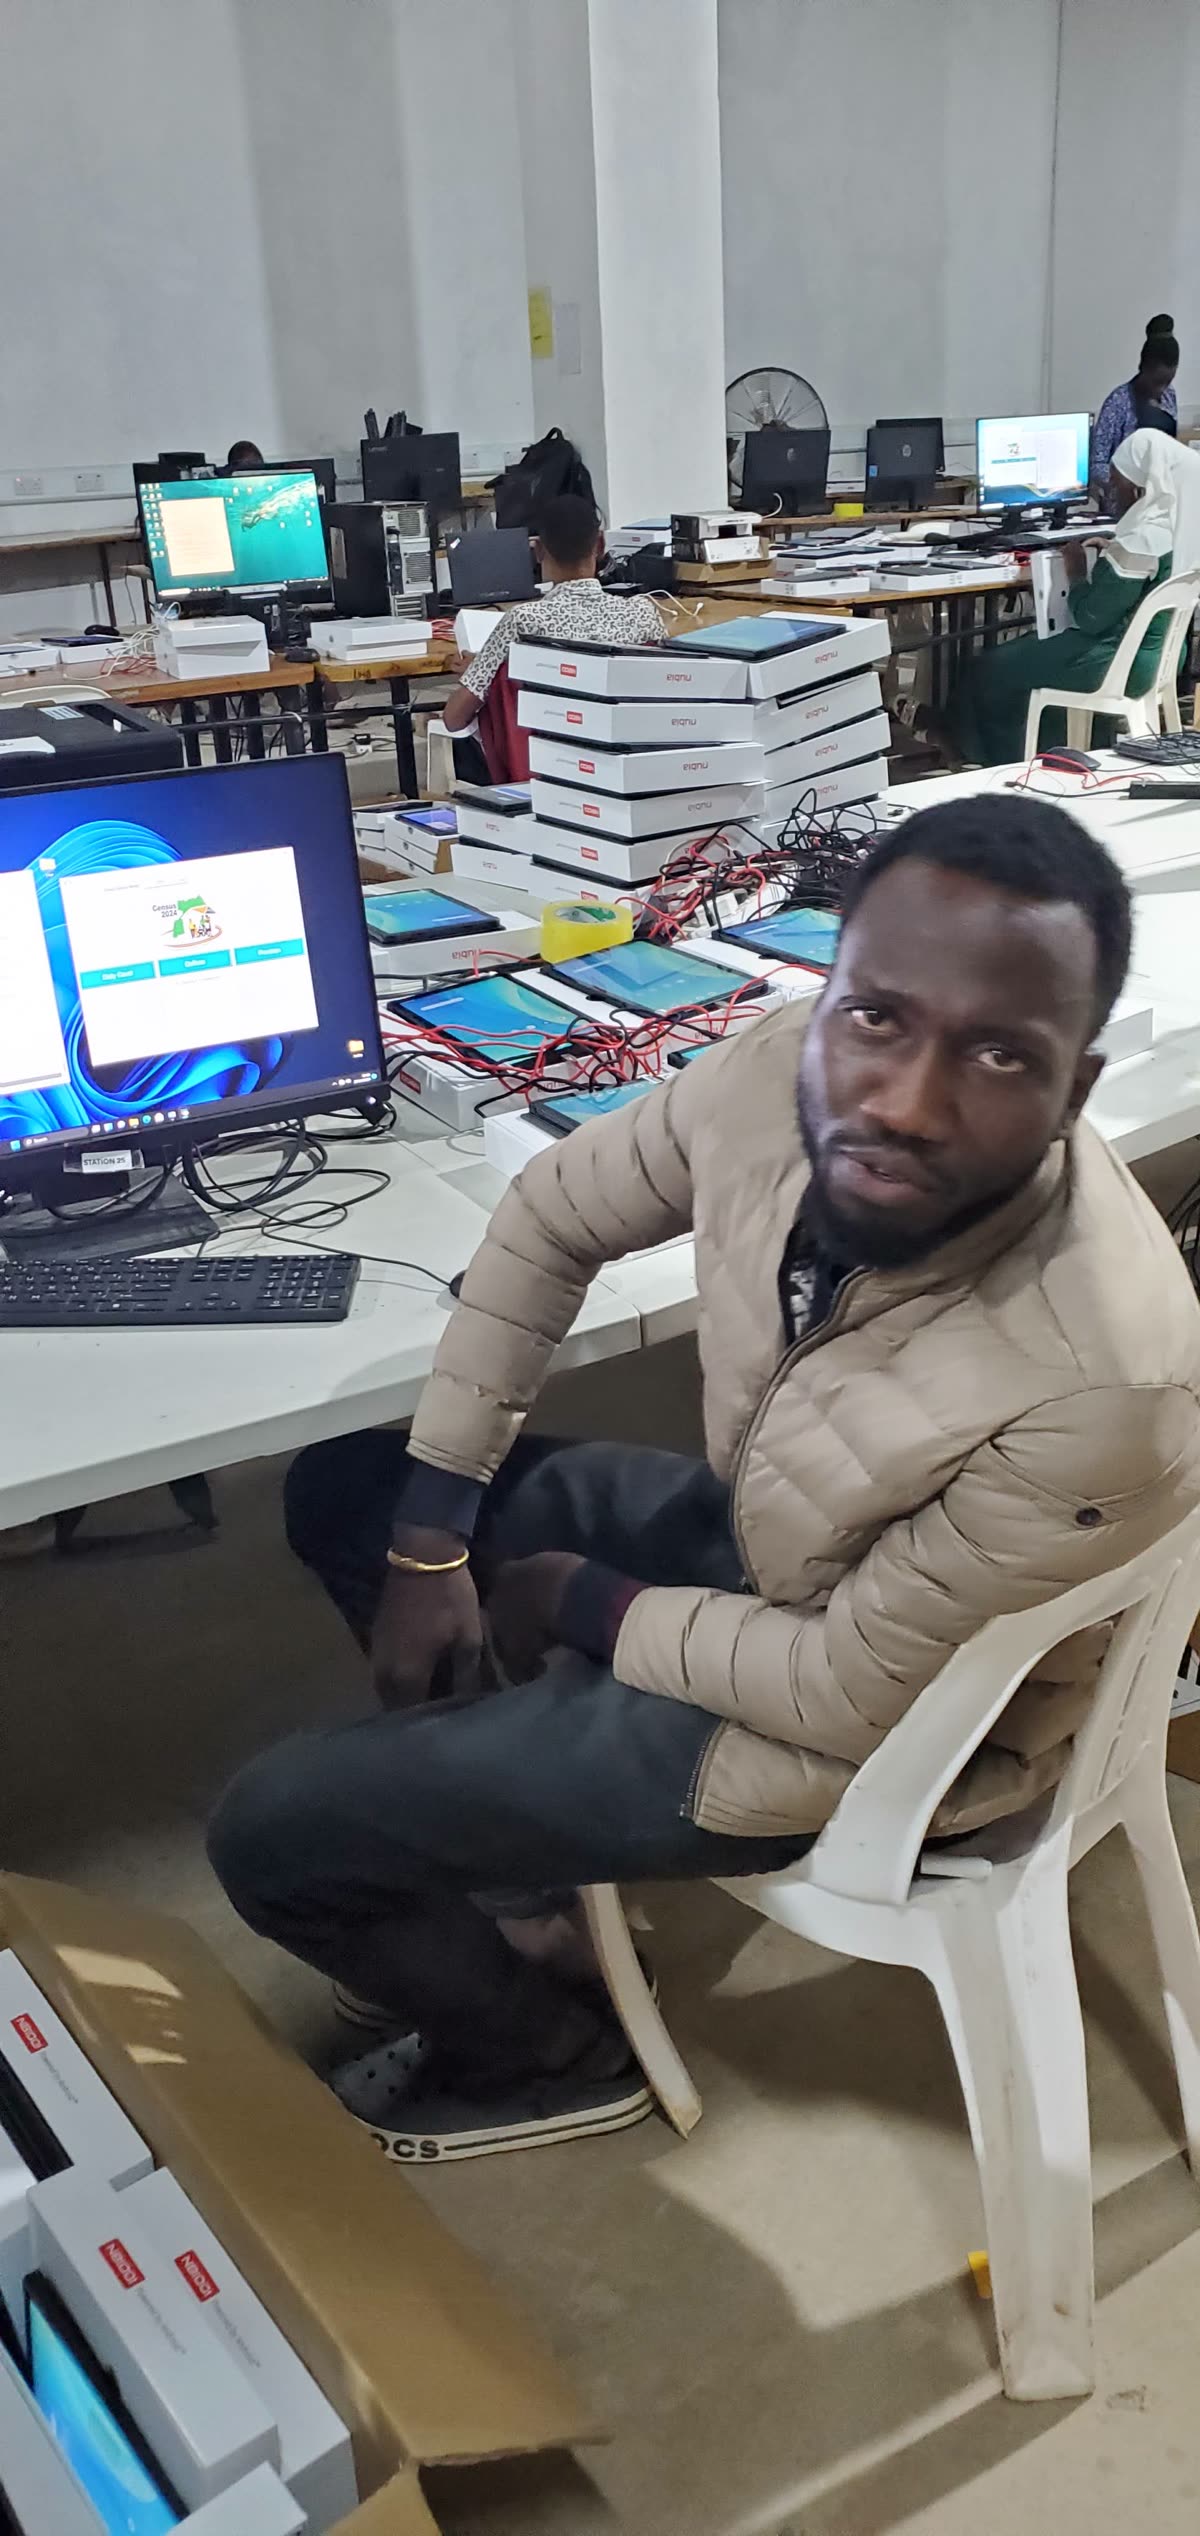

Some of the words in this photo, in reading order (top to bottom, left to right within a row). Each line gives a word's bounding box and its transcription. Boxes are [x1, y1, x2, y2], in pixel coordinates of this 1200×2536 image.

[152, 904, 177, 912] Census
[161, 910, 178, 918] 2024
[83, 1158, 115, 1166] STATION
